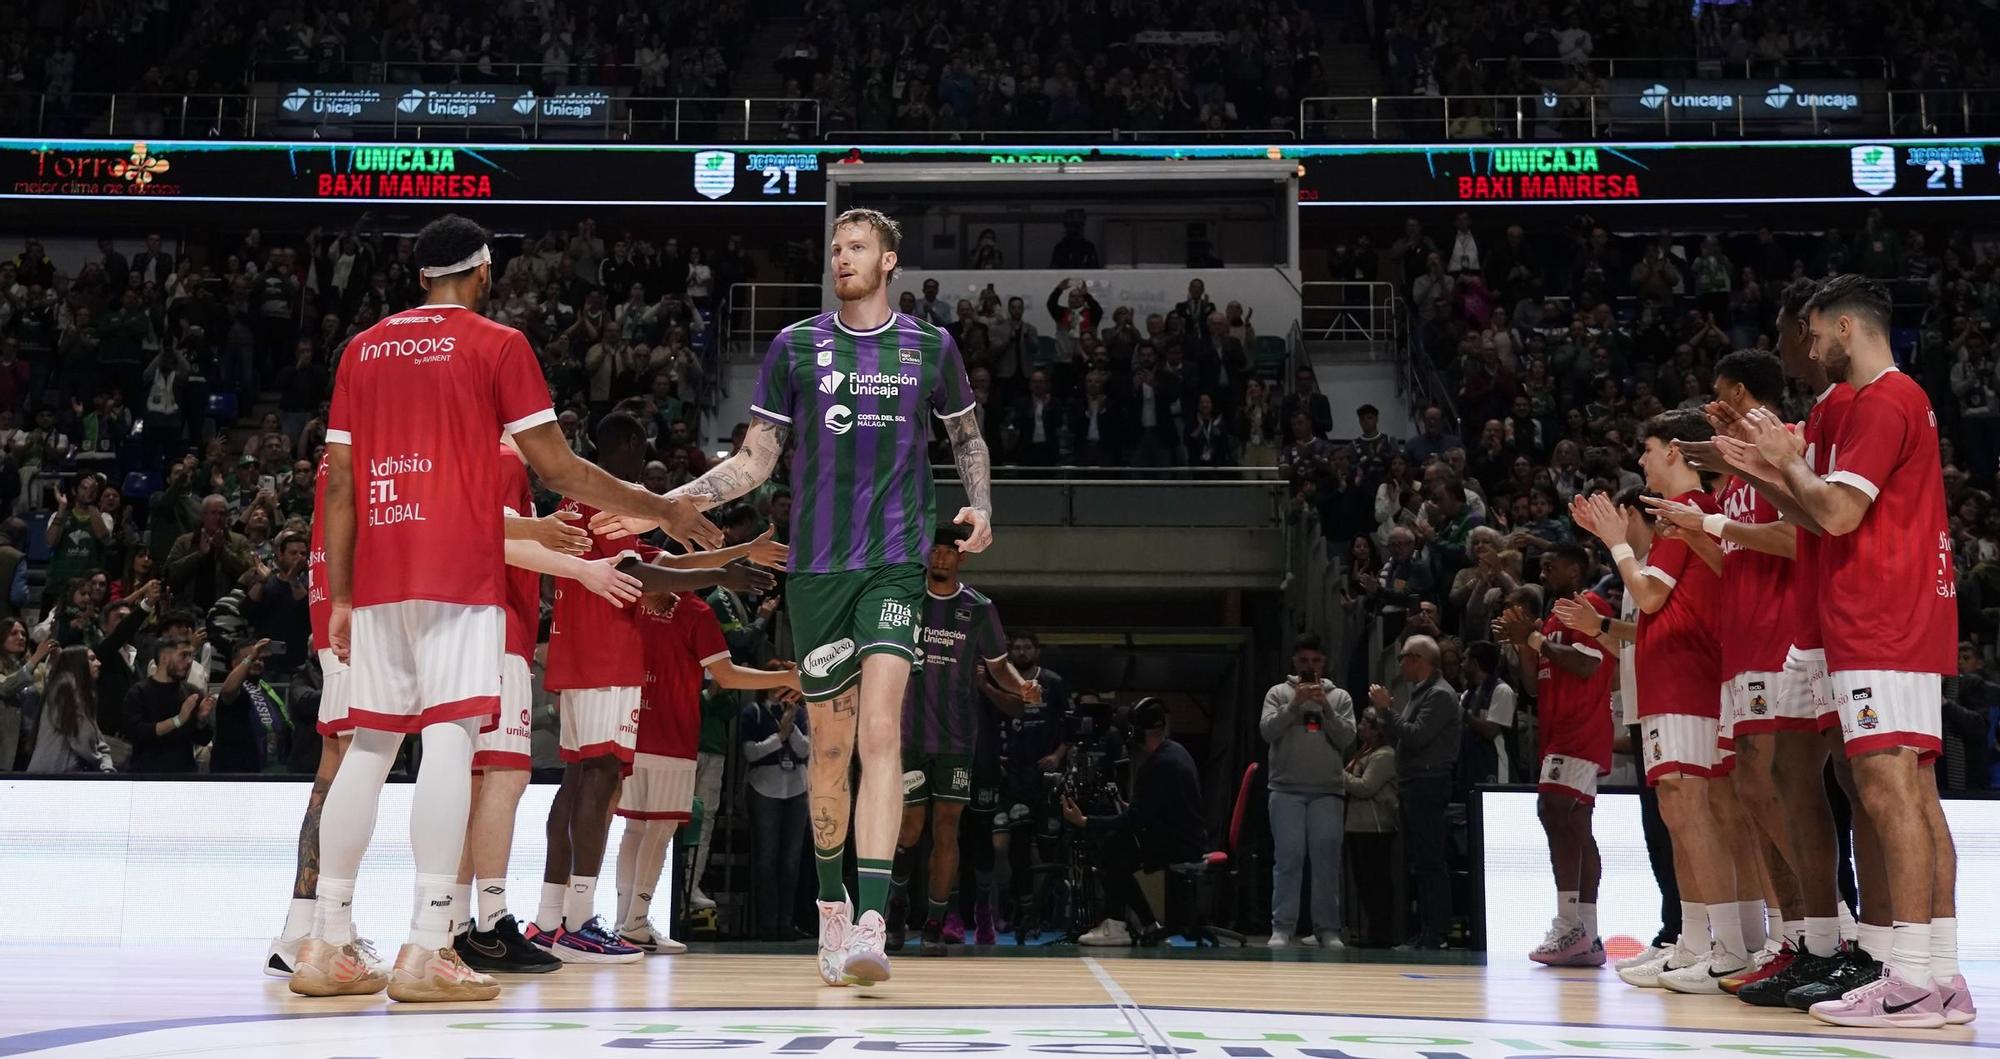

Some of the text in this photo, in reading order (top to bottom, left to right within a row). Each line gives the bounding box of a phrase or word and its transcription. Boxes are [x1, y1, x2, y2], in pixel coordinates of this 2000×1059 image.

[313, 101, 362, 116] Unicaja
[428, 102, 477, 118] Unicaja
[543, 103, 592, 119] Unicaja
[355, 149, 455, 172] UNICAJA
[1495, 149, 1599, 172] UNICAJA
[762, 166, 797, 195] 21
[1924, 160, 1963, 189] 21
[317, 173, 492, 198] BAXI MANRESA
[1458, 174, 1640, 199] BAXI MANRESA
[360, 336, 457, 362] inmoovs
[423, 354, 452, 363] AVINENT
[850, 371, 918, 387] Fundación
[850, 383, 899, 398] Unicaja
[857, 413, 880, 421] COSTA
[880, 414, 894, 422] DEL
[857, 420, 886, 428] MÁLAGA
[371, 453, 432, 477] Adbisio
[370, 479, 398, 504] ETL
[369, 502, 426, 527] GLOBAL
[923, 634, 954, 647] Unicaja
[924, 626, 966, 641] Fundación
